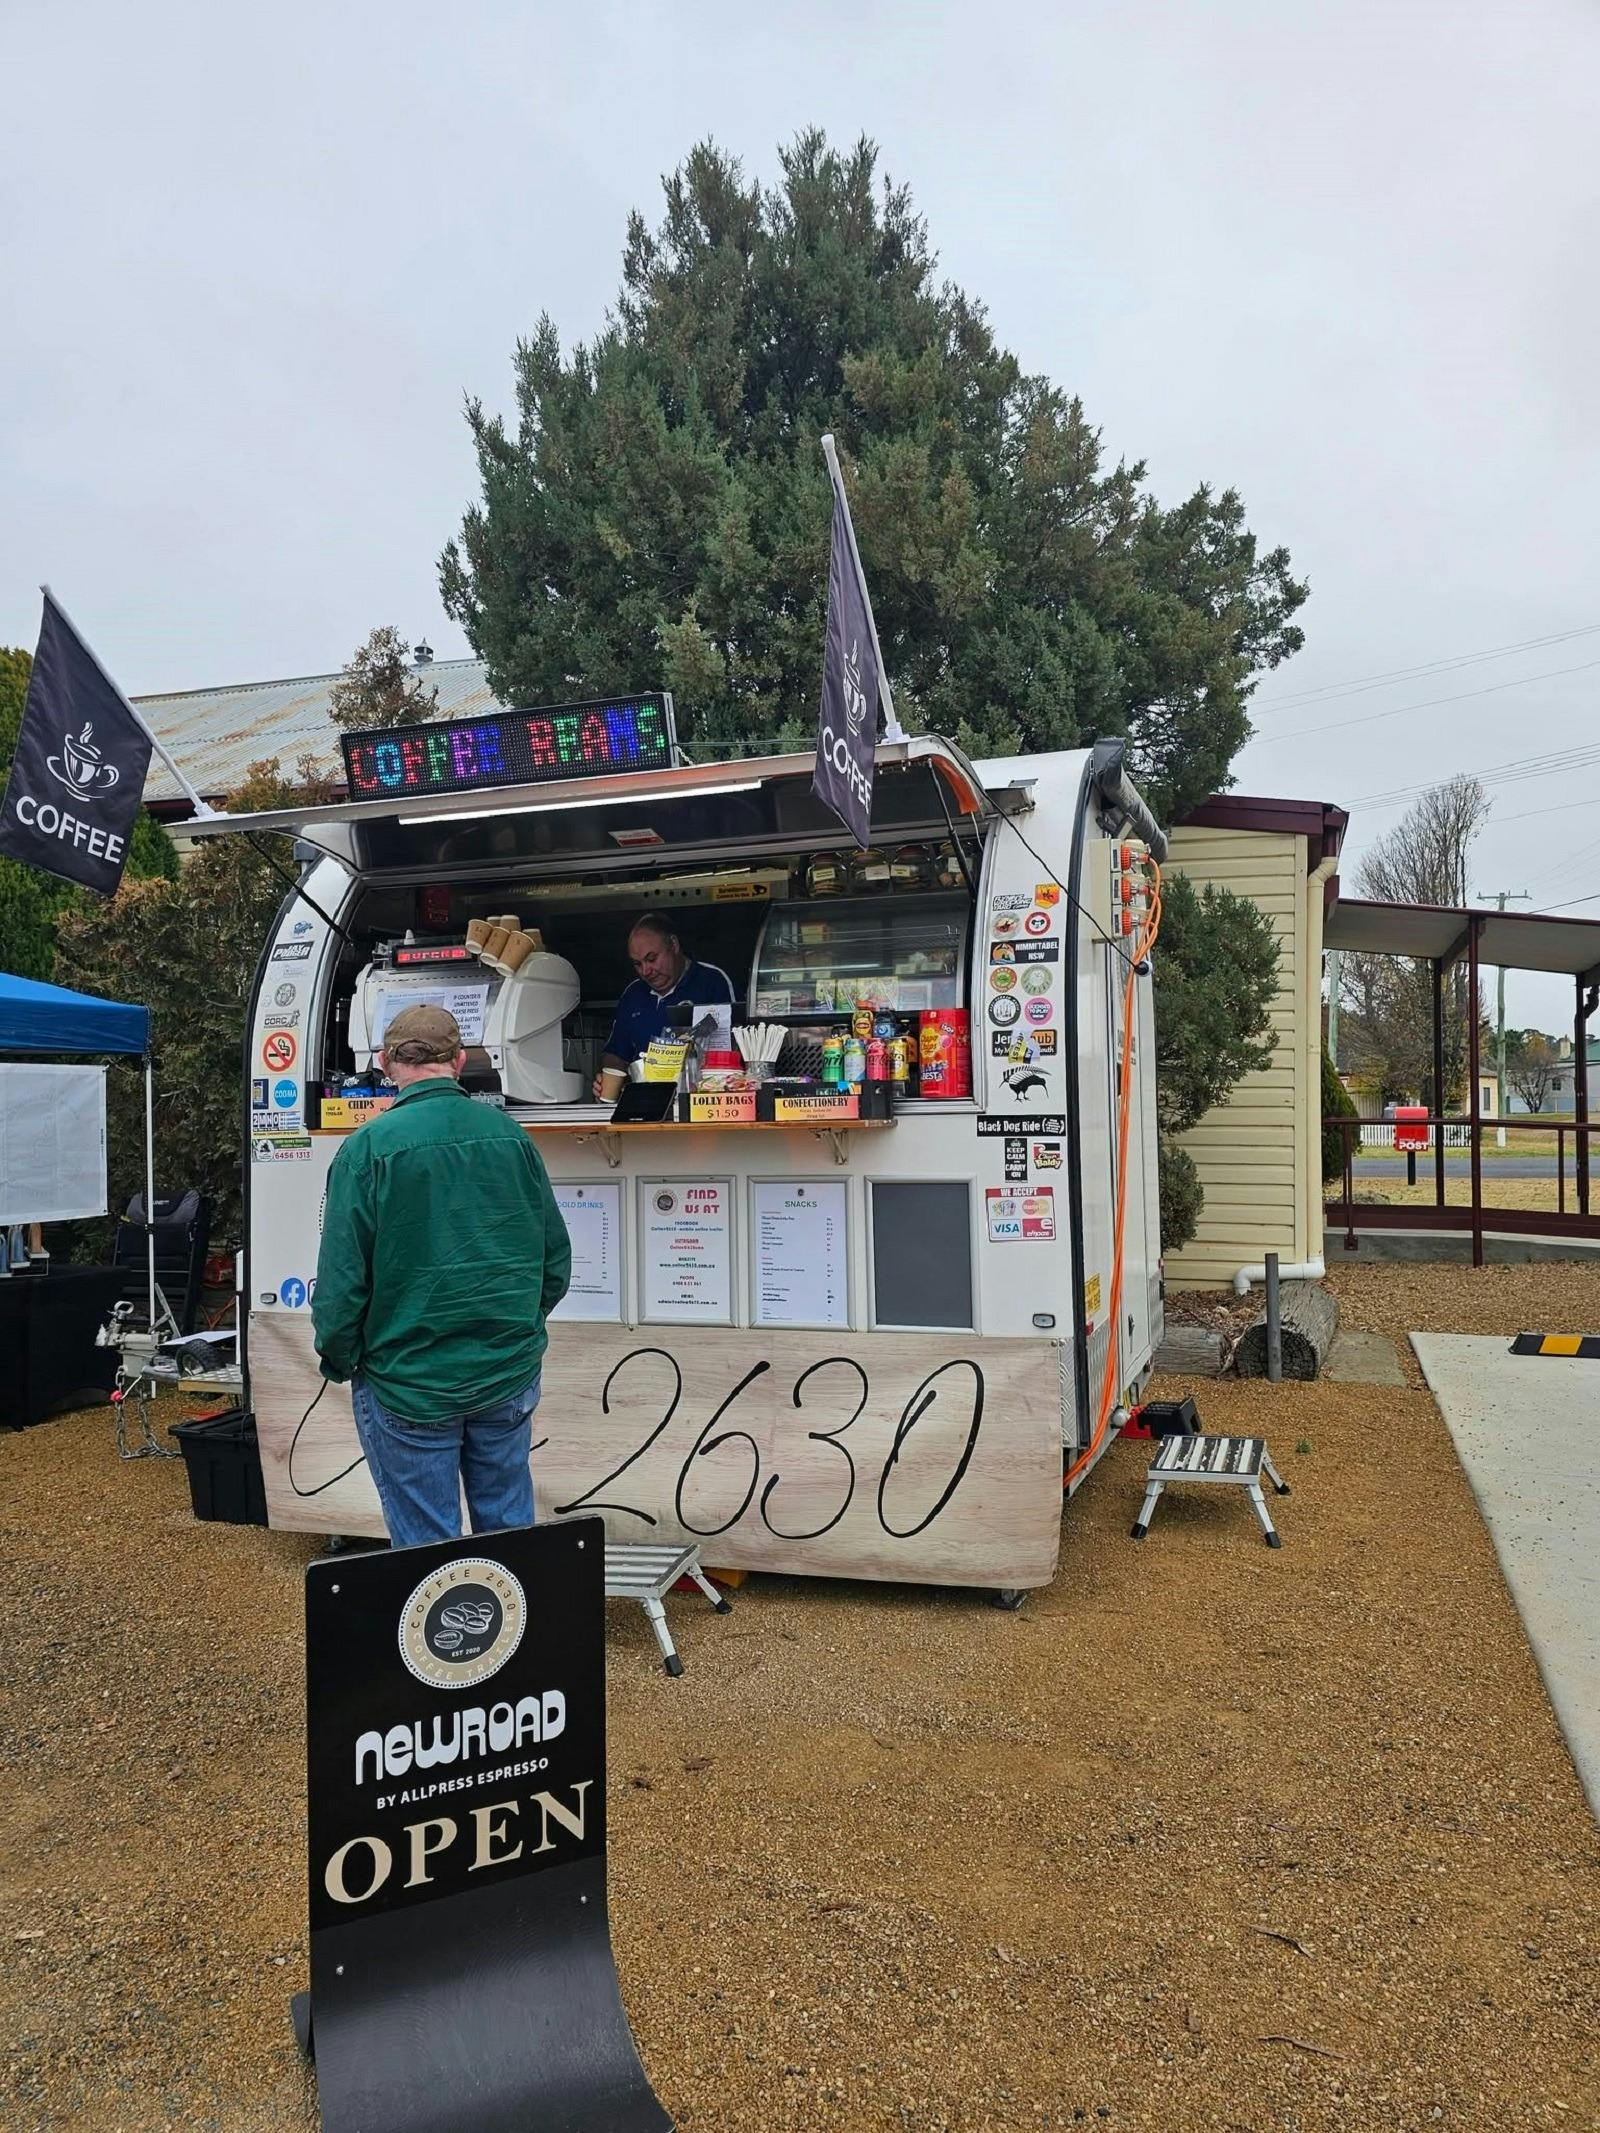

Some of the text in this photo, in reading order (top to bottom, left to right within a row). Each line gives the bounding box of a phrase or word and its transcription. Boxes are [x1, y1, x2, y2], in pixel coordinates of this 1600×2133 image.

[350, 703, 666, 790] COFFEE BEANS
[16, 795, 125, 864] COFFEE
[1015, 941, 1058, 951] NIMMITABEL
[1028, 952, 1045, 960] NSW
[274, 1088, 297, 1099] COOMA
[347, 1100, 375, 1110] CHIPS
[692, 1095, 754, 1106] LOLLY BAGS
[782, 1097, 849, 1108] CONFECTIONERY
[354, 1113, 367, 1123] $3
[707, 1109, 740, 1118] $1.50
[978, 1121, 1001, 1132] Black
[1003, 1120, 1021, 1133] Dog
[1022, 1121, 1040, 1132] Ride
[1399, 1142, 1428, 1150] POST
[296, 1151, 311, 1159] 1313
[1005, 1163, 1026, 1172] CARRY
[1034, 1159, 1062, 1169] Baldy
[686, 1189, 718, 1200] FIND
[1000, 1187, 1038, 1197] WE ACCEPT
[577, 1201, 604, 1209] DRINKS
[684, 1204, 720, 1214] US AT
[784, 1200, 818, 1208] SNACKS
[993, 1223, 1020, 1233] VISA
[554, 1346, 985, 1540] 2630
[411, 1569, 516, 1629] COFFEE 2630
[413, 1632, 455, 1680] COFFEE
[451, 1646, 481, 1657] EST 2020
[376, 1757, 549, 1810] BY ALLPRESS ESPRESSO
[324, 1779, 594, 1904] OPEN
